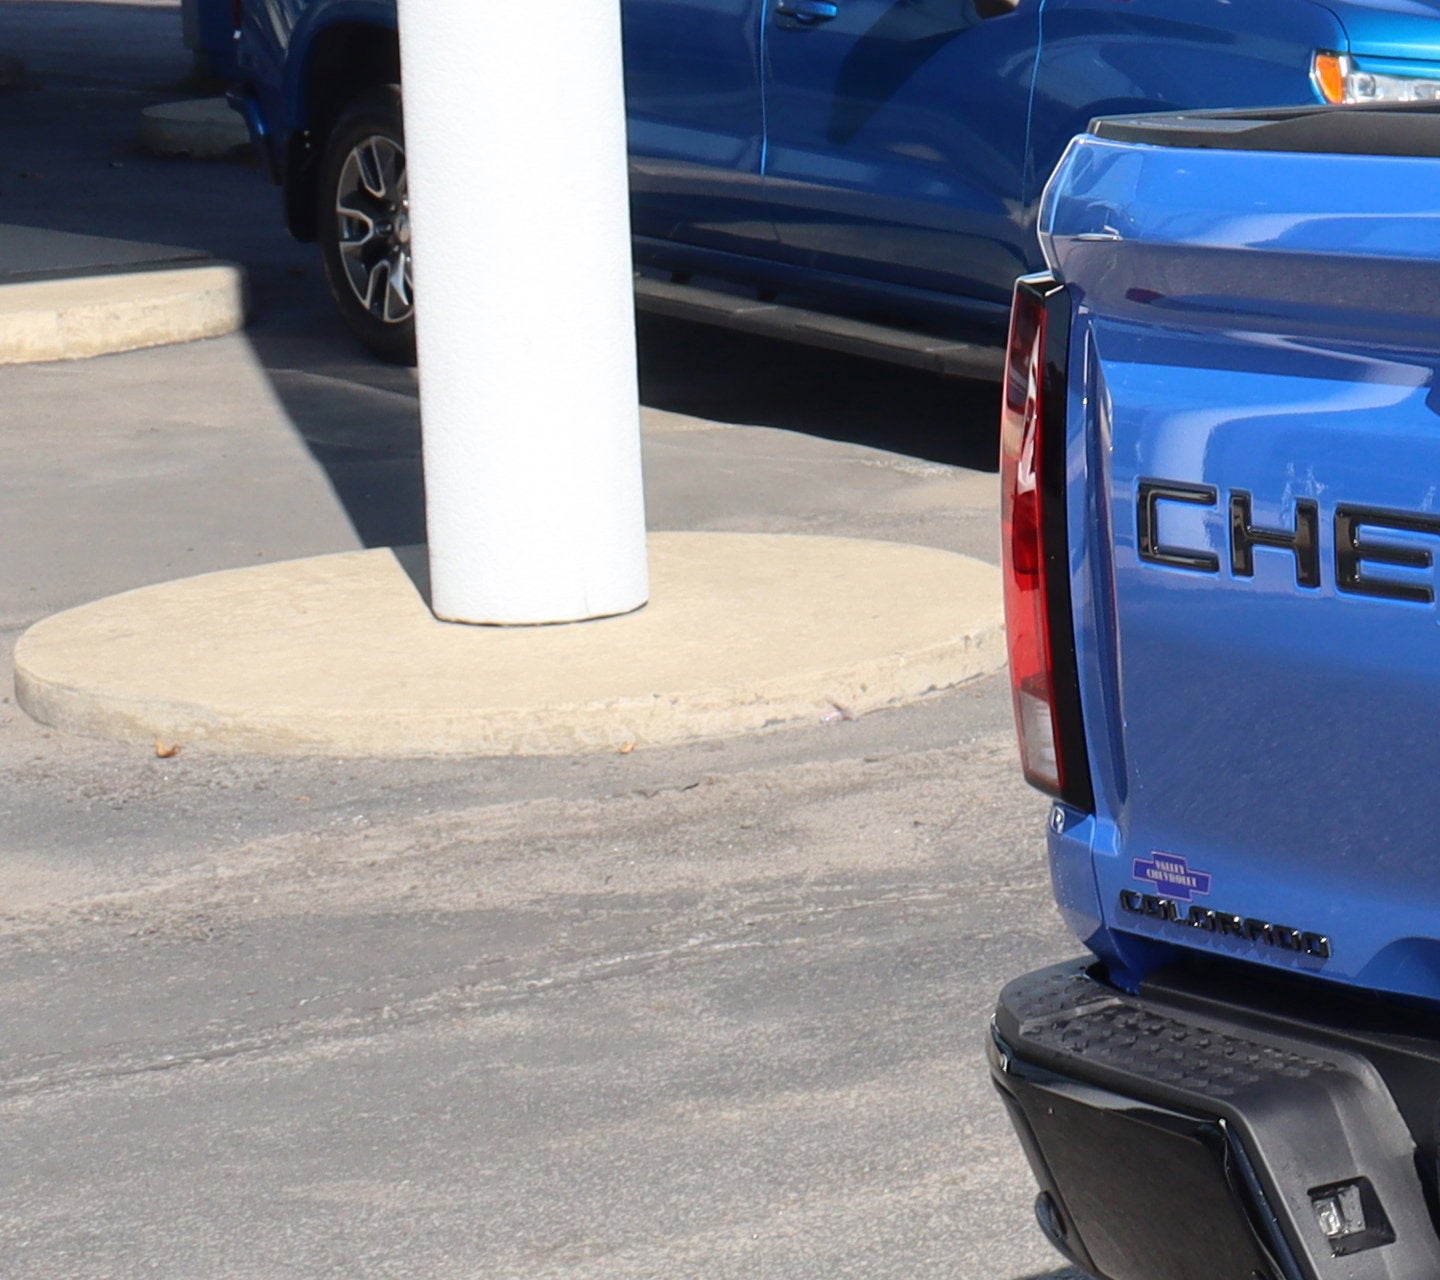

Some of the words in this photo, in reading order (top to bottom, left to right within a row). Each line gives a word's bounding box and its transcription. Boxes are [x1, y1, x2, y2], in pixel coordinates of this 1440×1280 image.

[1154, 858, 1186, 875] VALLEY
[1145, 867, 1198, 889] CHEVROLET
[1119, 888, 1333, 959] COLORADO
